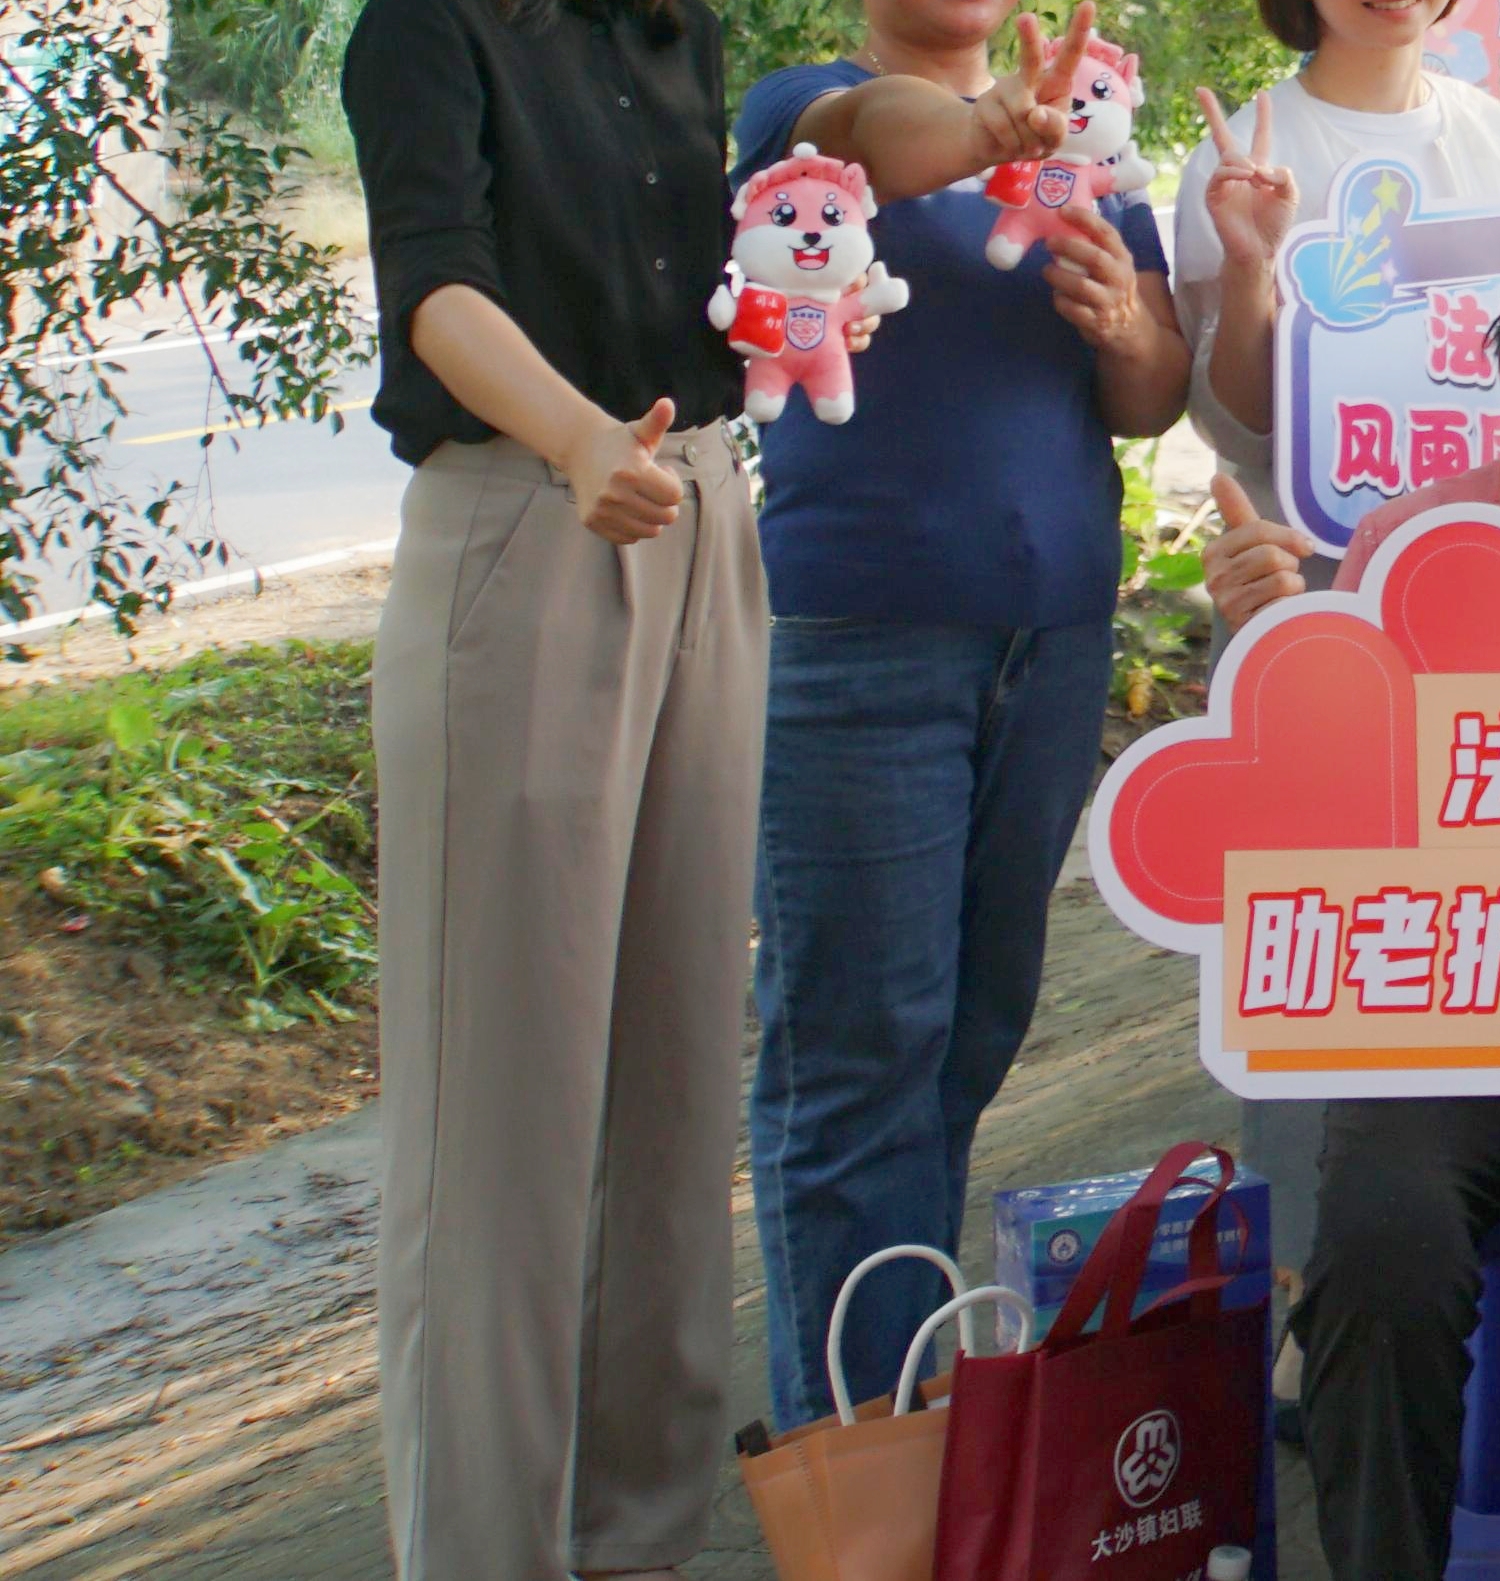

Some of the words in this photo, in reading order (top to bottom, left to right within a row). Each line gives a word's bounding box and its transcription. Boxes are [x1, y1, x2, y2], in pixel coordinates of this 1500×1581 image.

[1091, 1498, 1203, 1562] 大沙镇妇联
